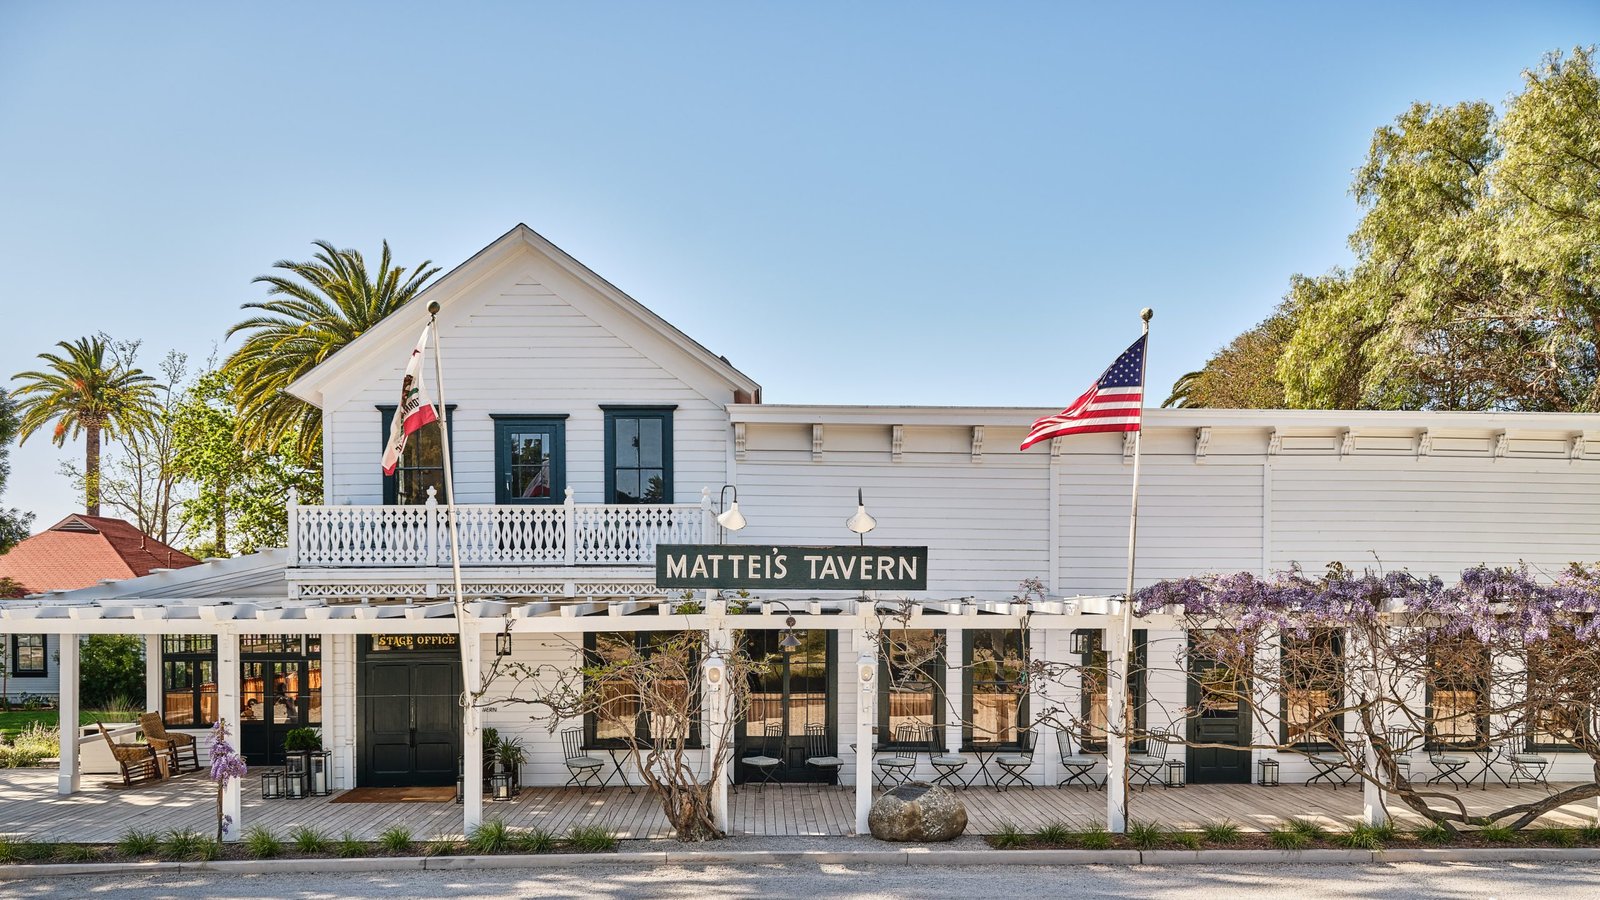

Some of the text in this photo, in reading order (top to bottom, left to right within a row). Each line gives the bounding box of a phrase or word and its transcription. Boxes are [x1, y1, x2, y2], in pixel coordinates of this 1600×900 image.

[666, 547, 918, 581] MATTEI'S TAVERN
[378, 636, 455, 646] STAGE OFFICE
